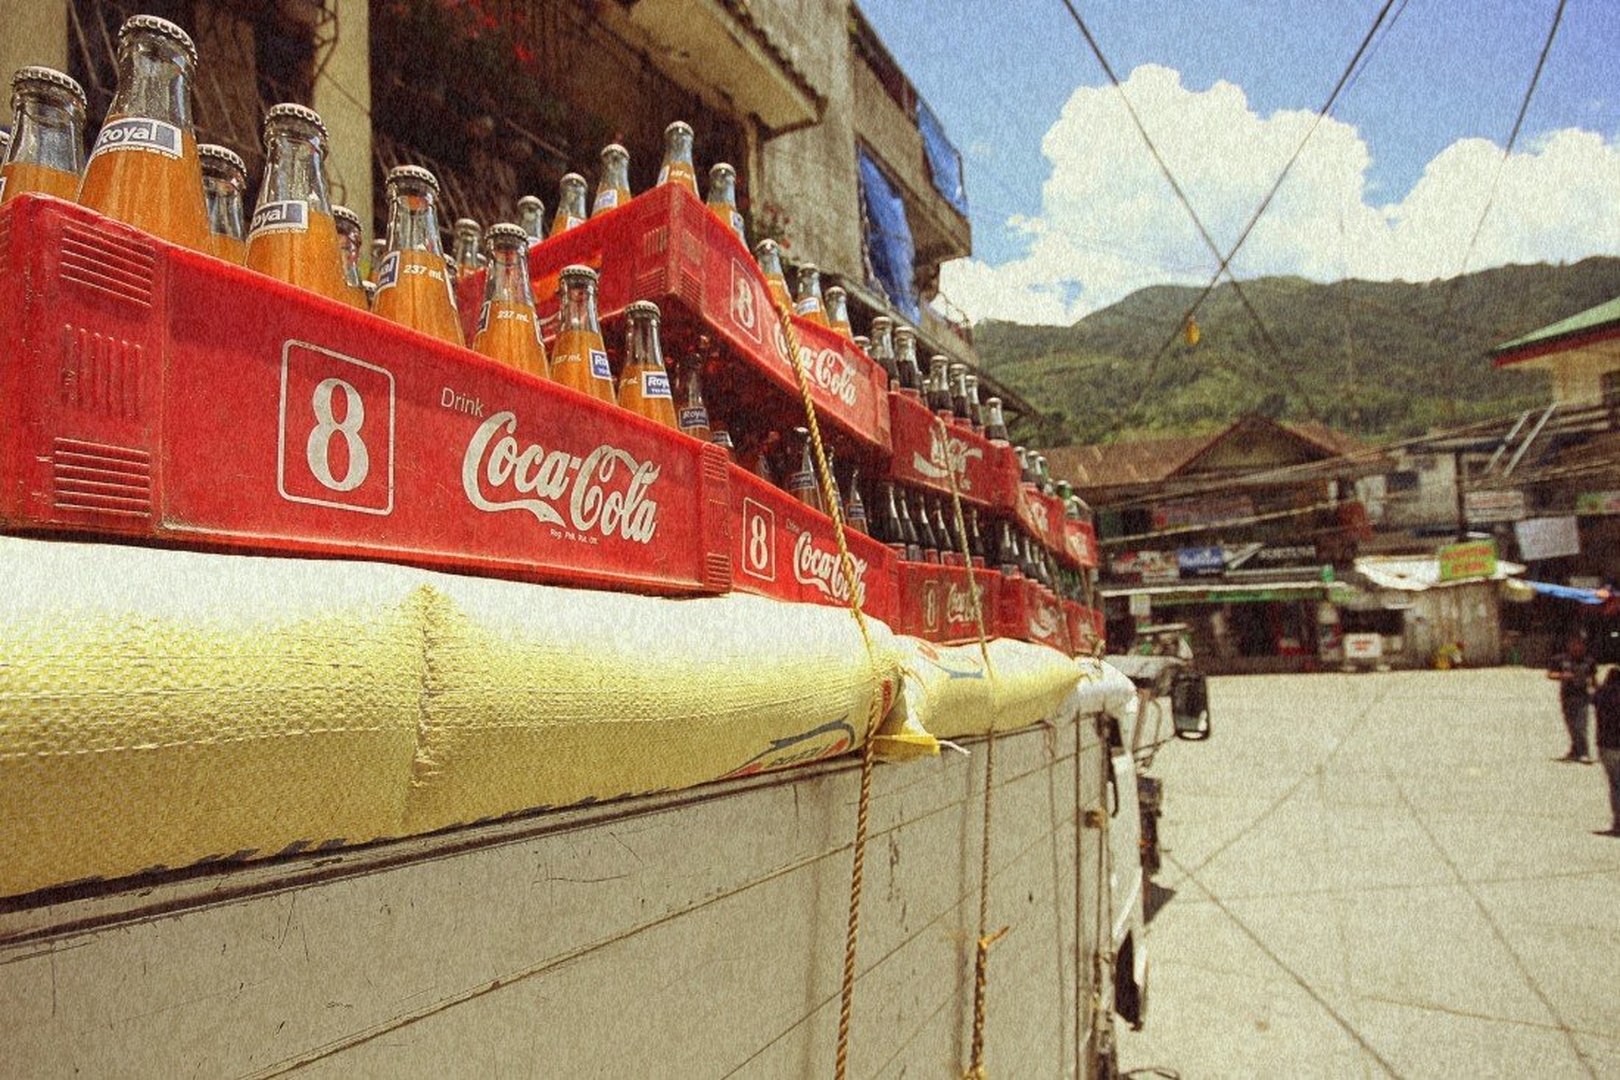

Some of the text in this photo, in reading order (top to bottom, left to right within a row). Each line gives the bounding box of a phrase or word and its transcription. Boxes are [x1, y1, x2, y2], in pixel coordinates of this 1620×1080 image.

[97, 122, 158, 148] Royal
[251, 203, 288, 230] oyal
[403, 264, 427, 275] 237
[497, 310, 514, 320] 237
[738, 278, 755, 329] 8
[441, 387, 484, 418] Drink
[306, 378, 369, 491] 8
[462, 410, 661, 544] Coca-Cola
[750, 515, 768, 570] 8
